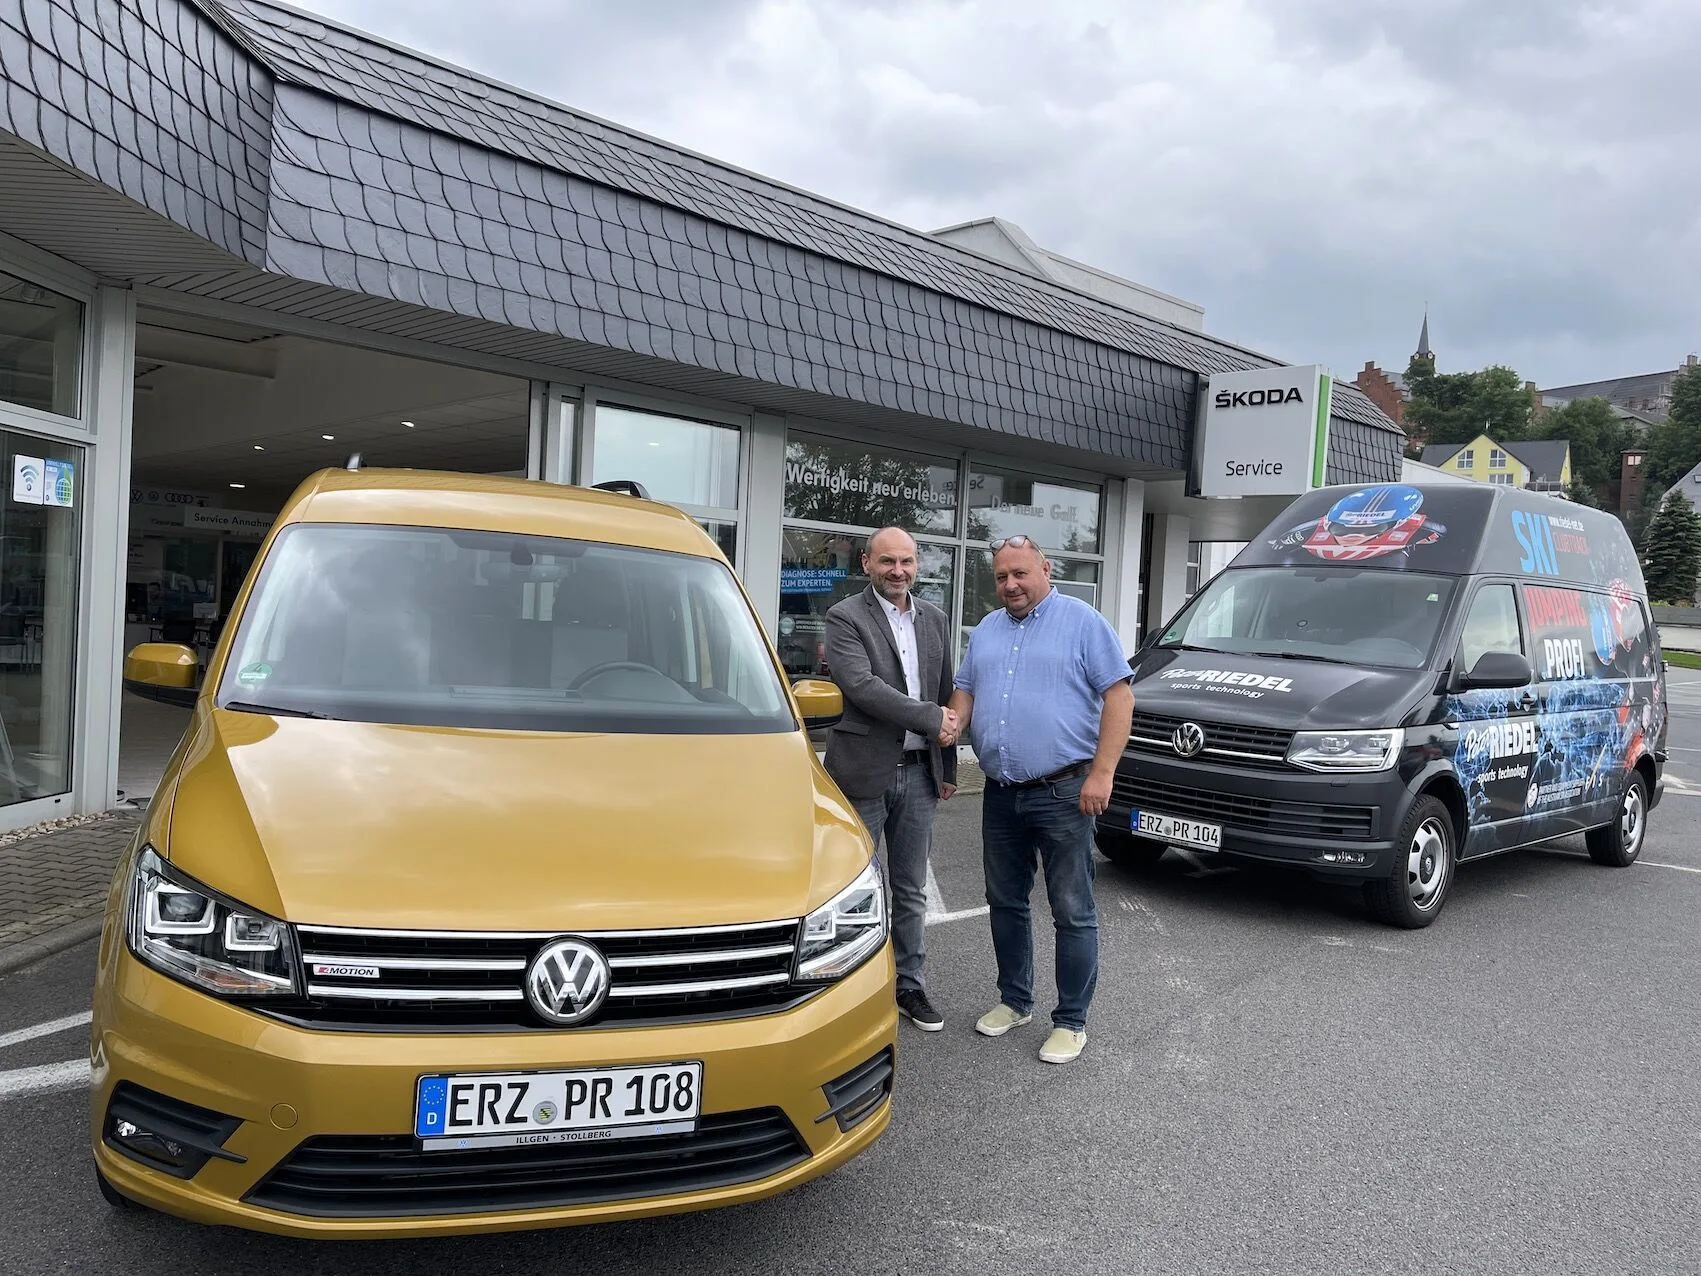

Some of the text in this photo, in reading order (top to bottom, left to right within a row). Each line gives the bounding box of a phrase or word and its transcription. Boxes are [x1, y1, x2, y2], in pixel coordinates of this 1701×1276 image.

[1215, 387, 1303, 409] ŠKODA
[1225, 458, 1283, 477] Service
[786, 461, 869, 494] Wertigkeit
[872, 482, 900, 498] neu
[903, 482, 957, 506] erleben.
[990, 495, 1012, 512] Der
[1014, 503, 1044, 518] neue
[194, 512, 229, 526] Service
[231, 516, 273, 529] Annahm
[1511, 510, 1560, 576] SKI
[781, 569, 817, 578] DIAGNOSE:
[797, 579, 832, 587] EXPERTEN.
[1543, 638, 1586, 680] PROFI
[1170, 682, 1264, 699] sports technology
[1196, 669, 1294, 692] RIEDEL
[1489, 721, 1538, 759] RIEDEL
[1477, 763, 1529, 784] sports technology
[1139, 814, 1163, 833] ERZ
[1173, 820, 1190, 839] PR
[1193, 825, 1218, 844] 104
[448, 1070, 694, 1128] ERZ PR 108
[425, 1111, 438, 1126] D
[515, 1130, 612, 1145] ILLGEN STOLLBERG
